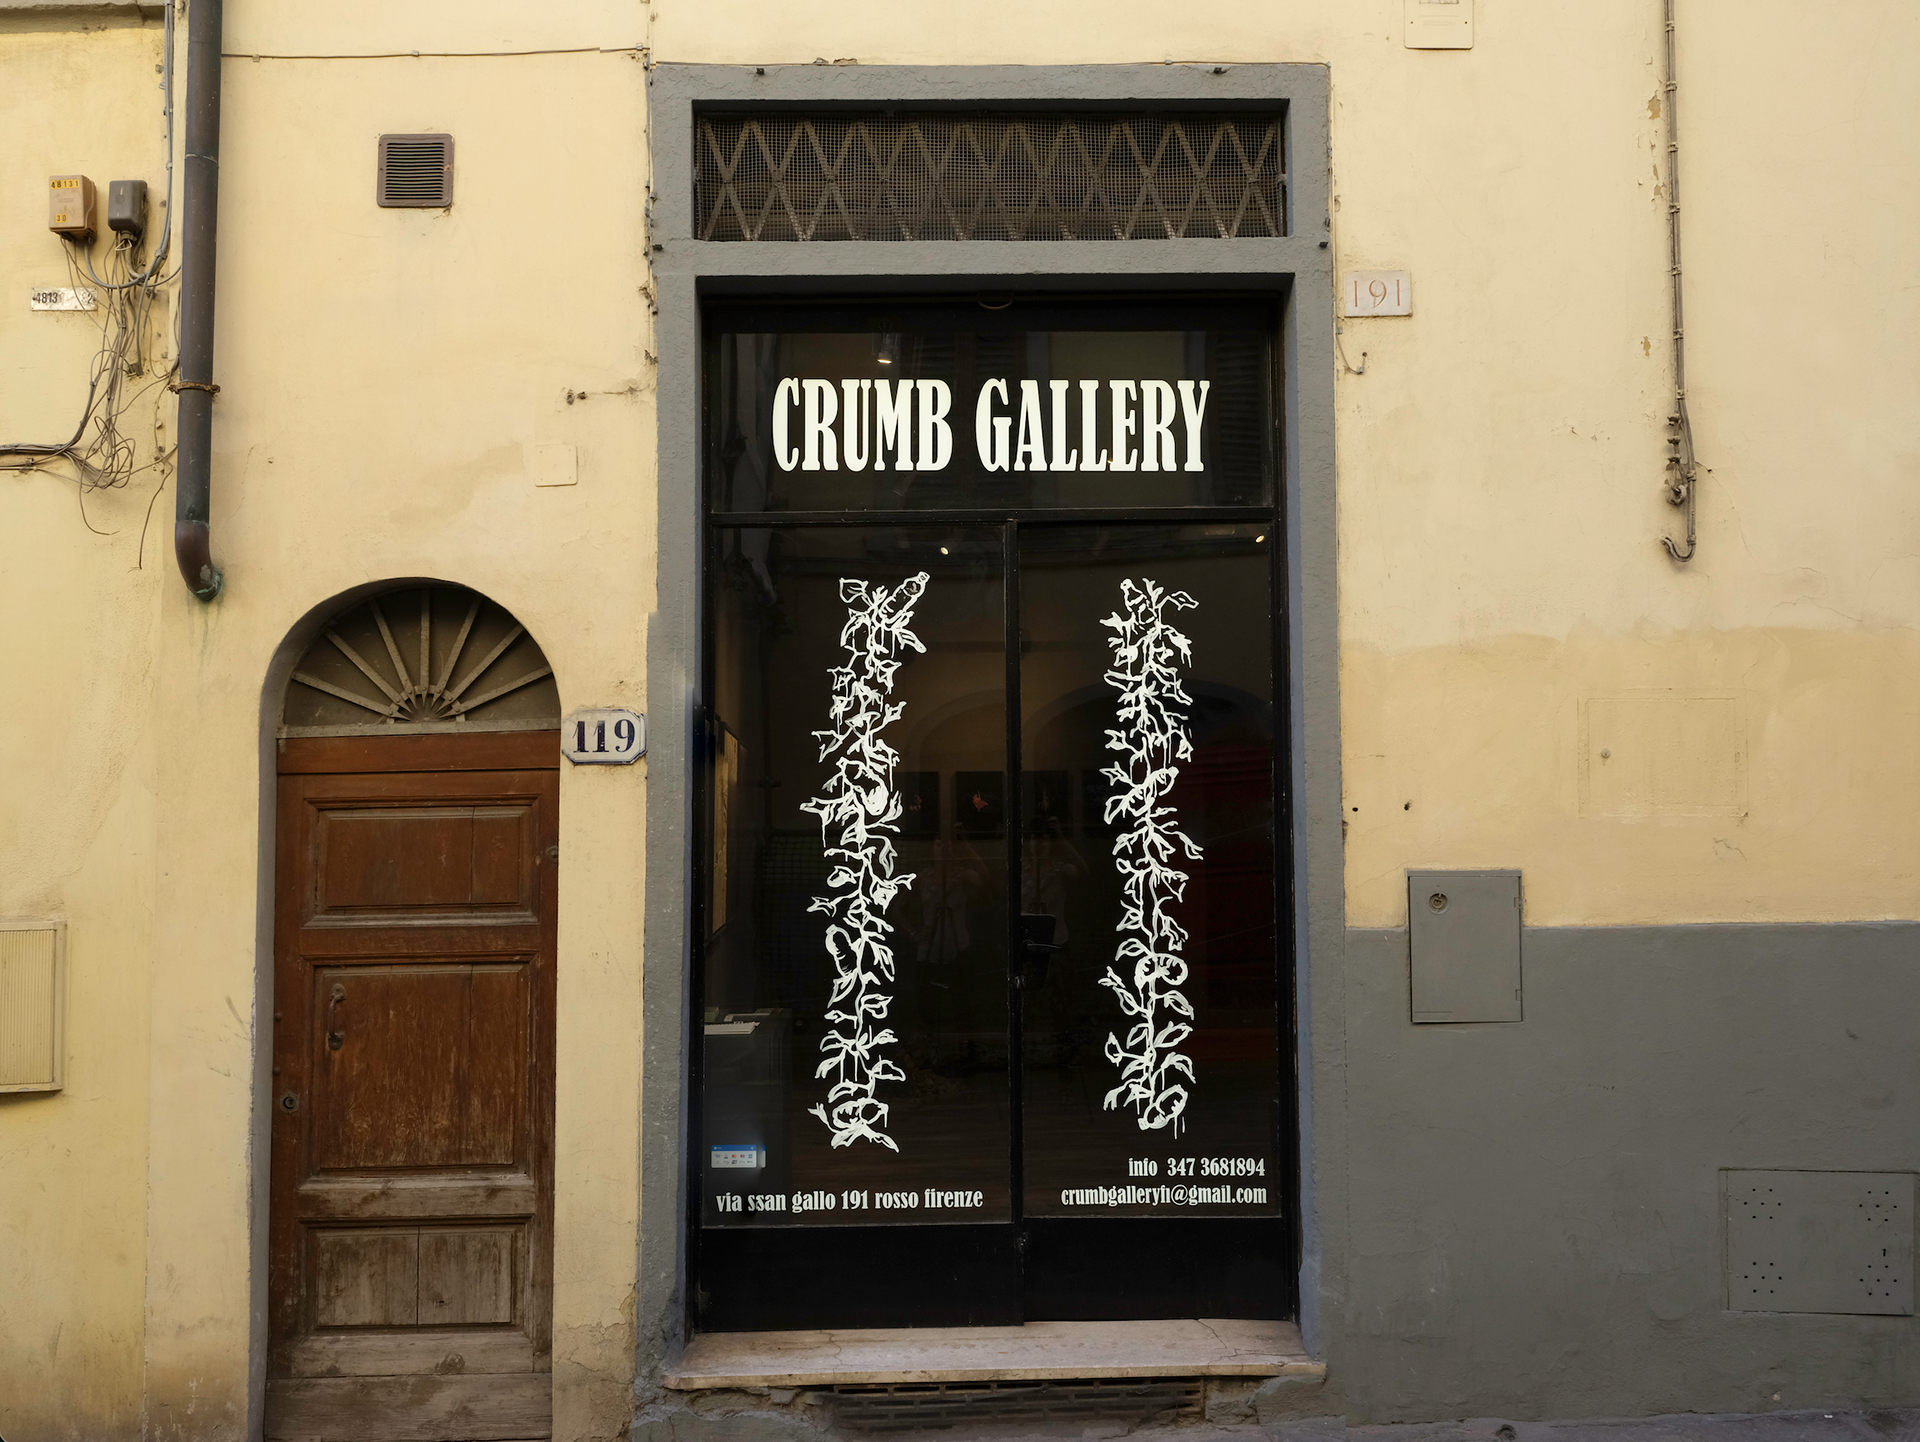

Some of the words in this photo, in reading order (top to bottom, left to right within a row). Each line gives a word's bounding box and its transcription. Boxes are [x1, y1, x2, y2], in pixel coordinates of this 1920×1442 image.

[1354, 279, 1400, 309] 191
[772, 377, 953, 472] CRUMB
[975, 378, 1211, 472] GALLERY
[572, 719, 635, 753] 119
[1128, 1157, 1158, 1177] info
[1167, 1157, 1196, 1176] 347
[1200, 1157, 1266, 1176] 3681894
[716, 1192, 742, 1212] via
[792, 1190, 836, 1214] gallo
[841, 1190, 868, 1210] 191
[874, 1191, 919, 1209] rosso
[924, 1188, 984, 1208] firenze
[1061, 1184, 1267, 1207] crumbgalleryfi@gmail.com
